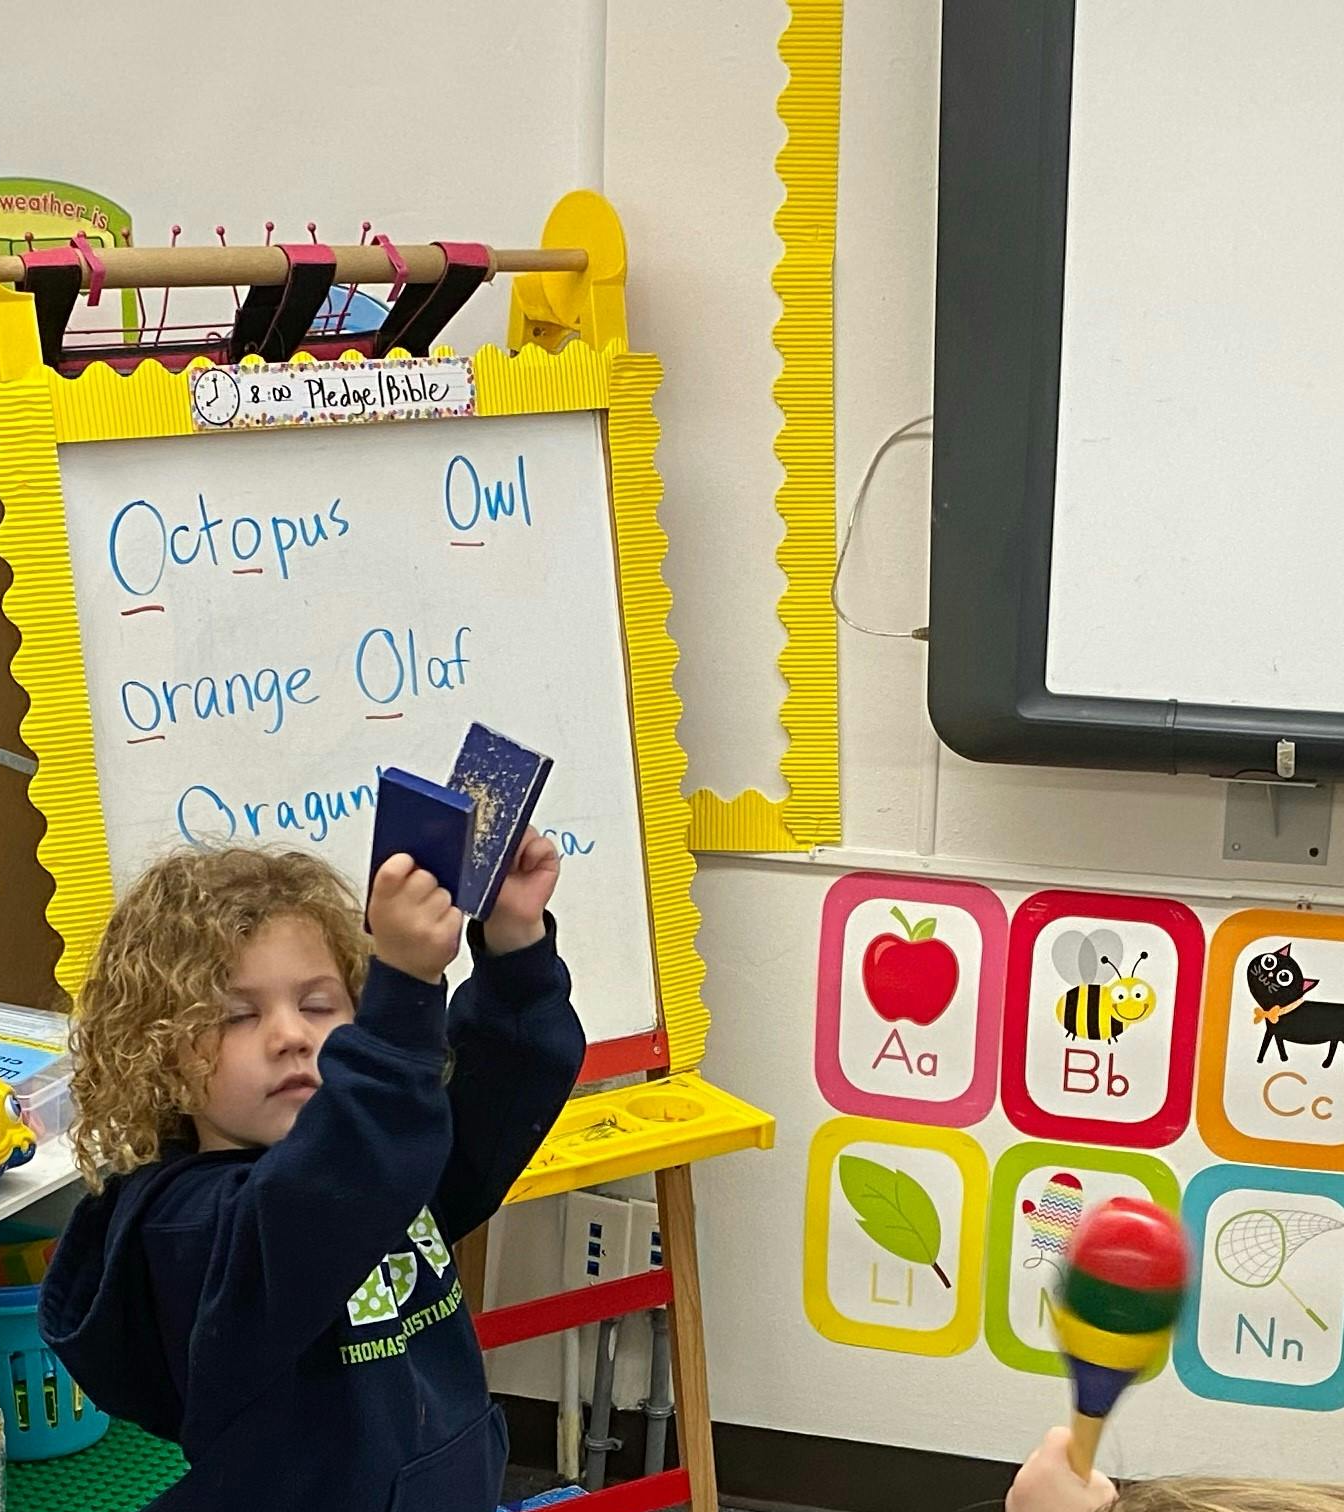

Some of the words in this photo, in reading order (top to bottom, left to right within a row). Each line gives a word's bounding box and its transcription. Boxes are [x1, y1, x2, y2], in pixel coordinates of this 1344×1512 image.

[0, 192, 85, 219] weather
[92, 207, 108, 229] is
[249, 384, 291, 404] 8:00
[304, 371, 449, 415] Pledge/Bible
[109, 494, 350, 596] Octopus
[445, 455, 532, 531] Owl
[356, 626, 471, 704] Olaf
[873, 1029, 938, 1078] Aa
[1063, 1048, 1130, 1098] Bb
[1262, 1072, 1333, 1121] Cc
[1235, 1313, 1303, 1362] Nn
